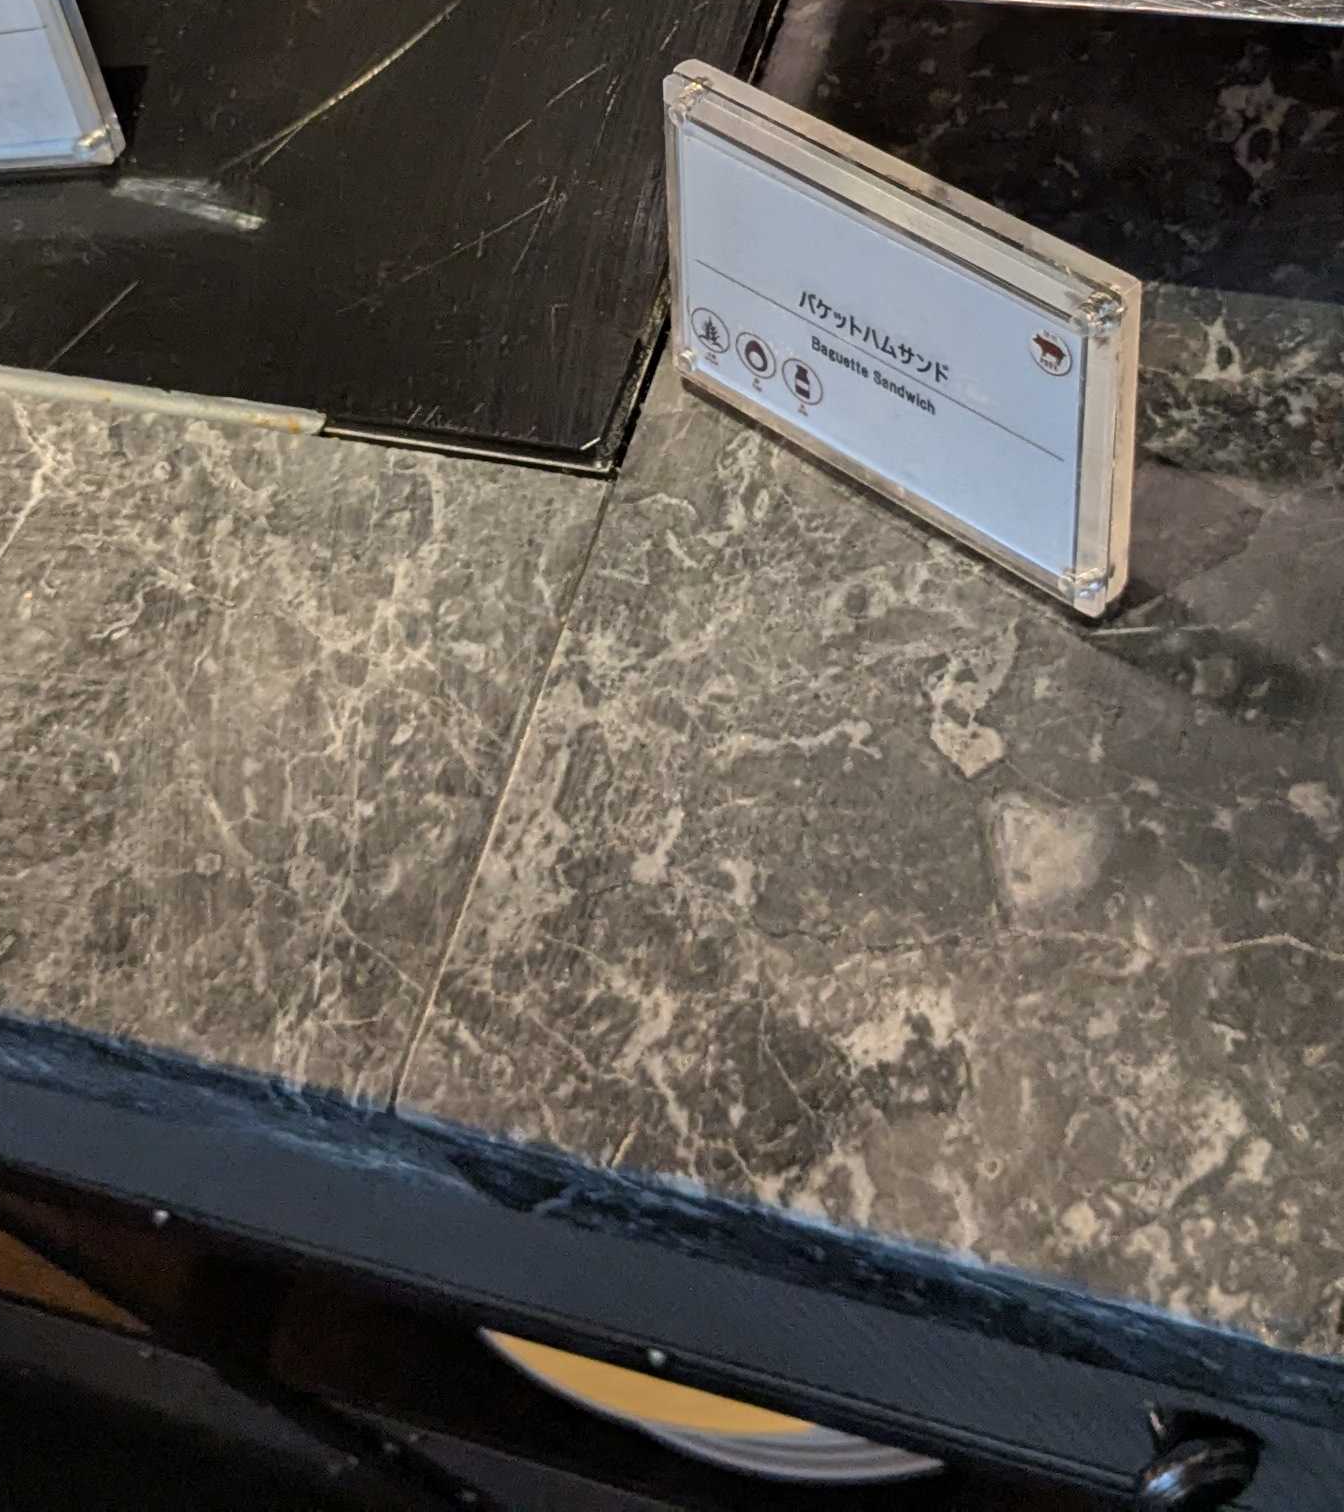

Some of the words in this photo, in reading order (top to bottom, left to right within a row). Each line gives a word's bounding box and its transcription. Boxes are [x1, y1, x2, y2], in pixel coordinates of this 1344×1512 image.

[798, 291, 950, 383] バケットハムサンド
[811, 335, 869, 379] Baguette
[872, 370, 936, 417] Sandwich
